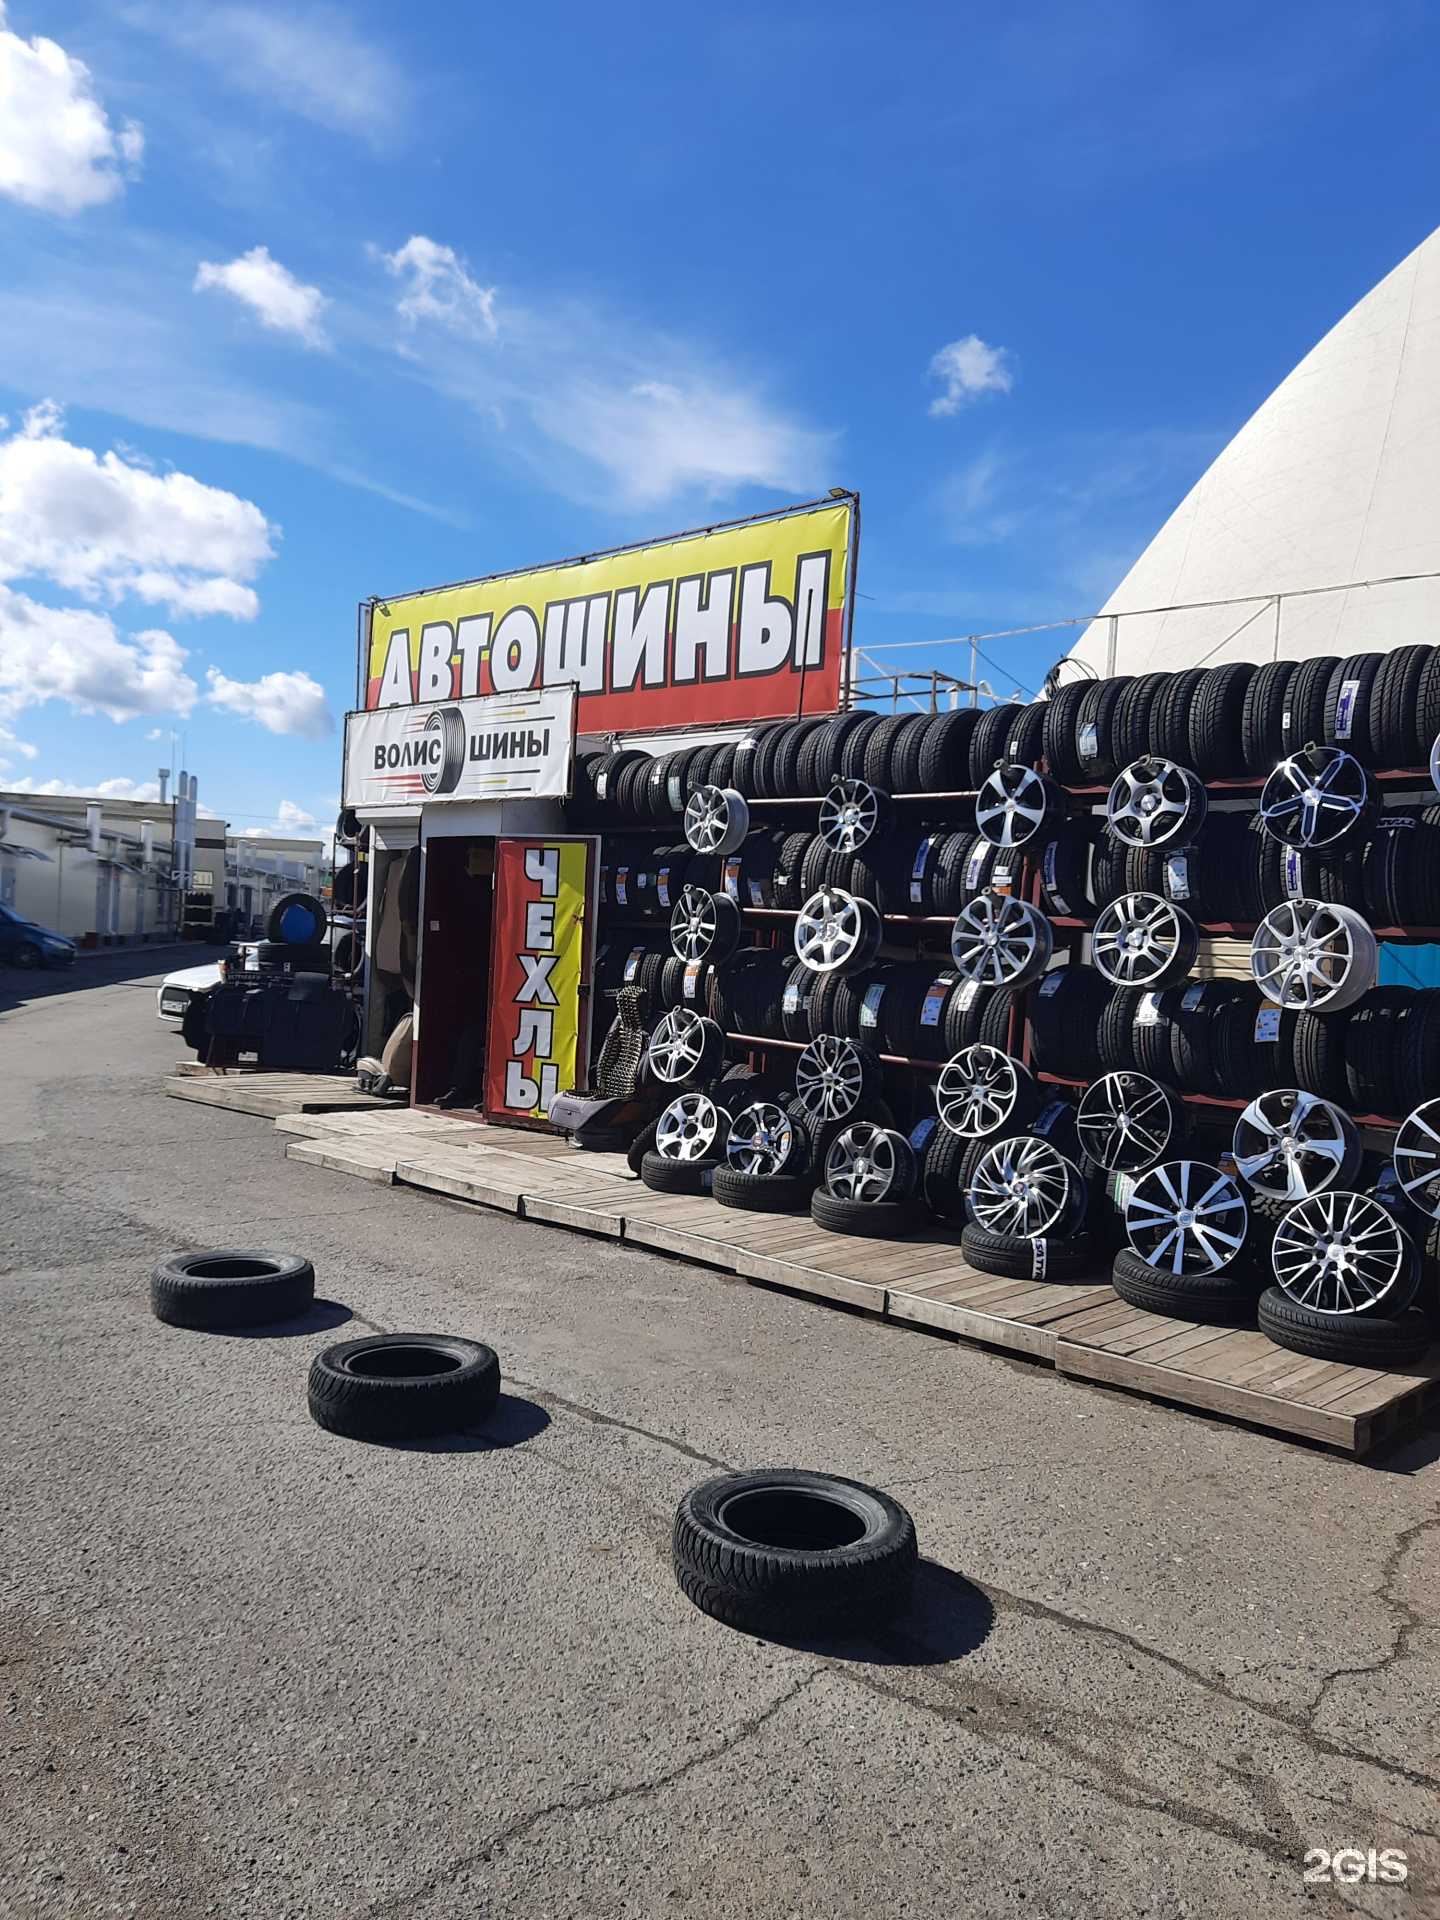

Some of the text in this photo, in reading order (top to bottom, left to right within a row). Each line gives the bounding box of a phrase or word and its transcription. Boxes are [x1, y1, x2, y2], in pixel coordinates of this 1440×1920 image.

[376, 549, 833, 709] АВТОШИНЫ
[374, 728, 550, 770] ВОЛИС ШИНЫ
[504, 847, 561, 1112] ЧЕХЛЫ
